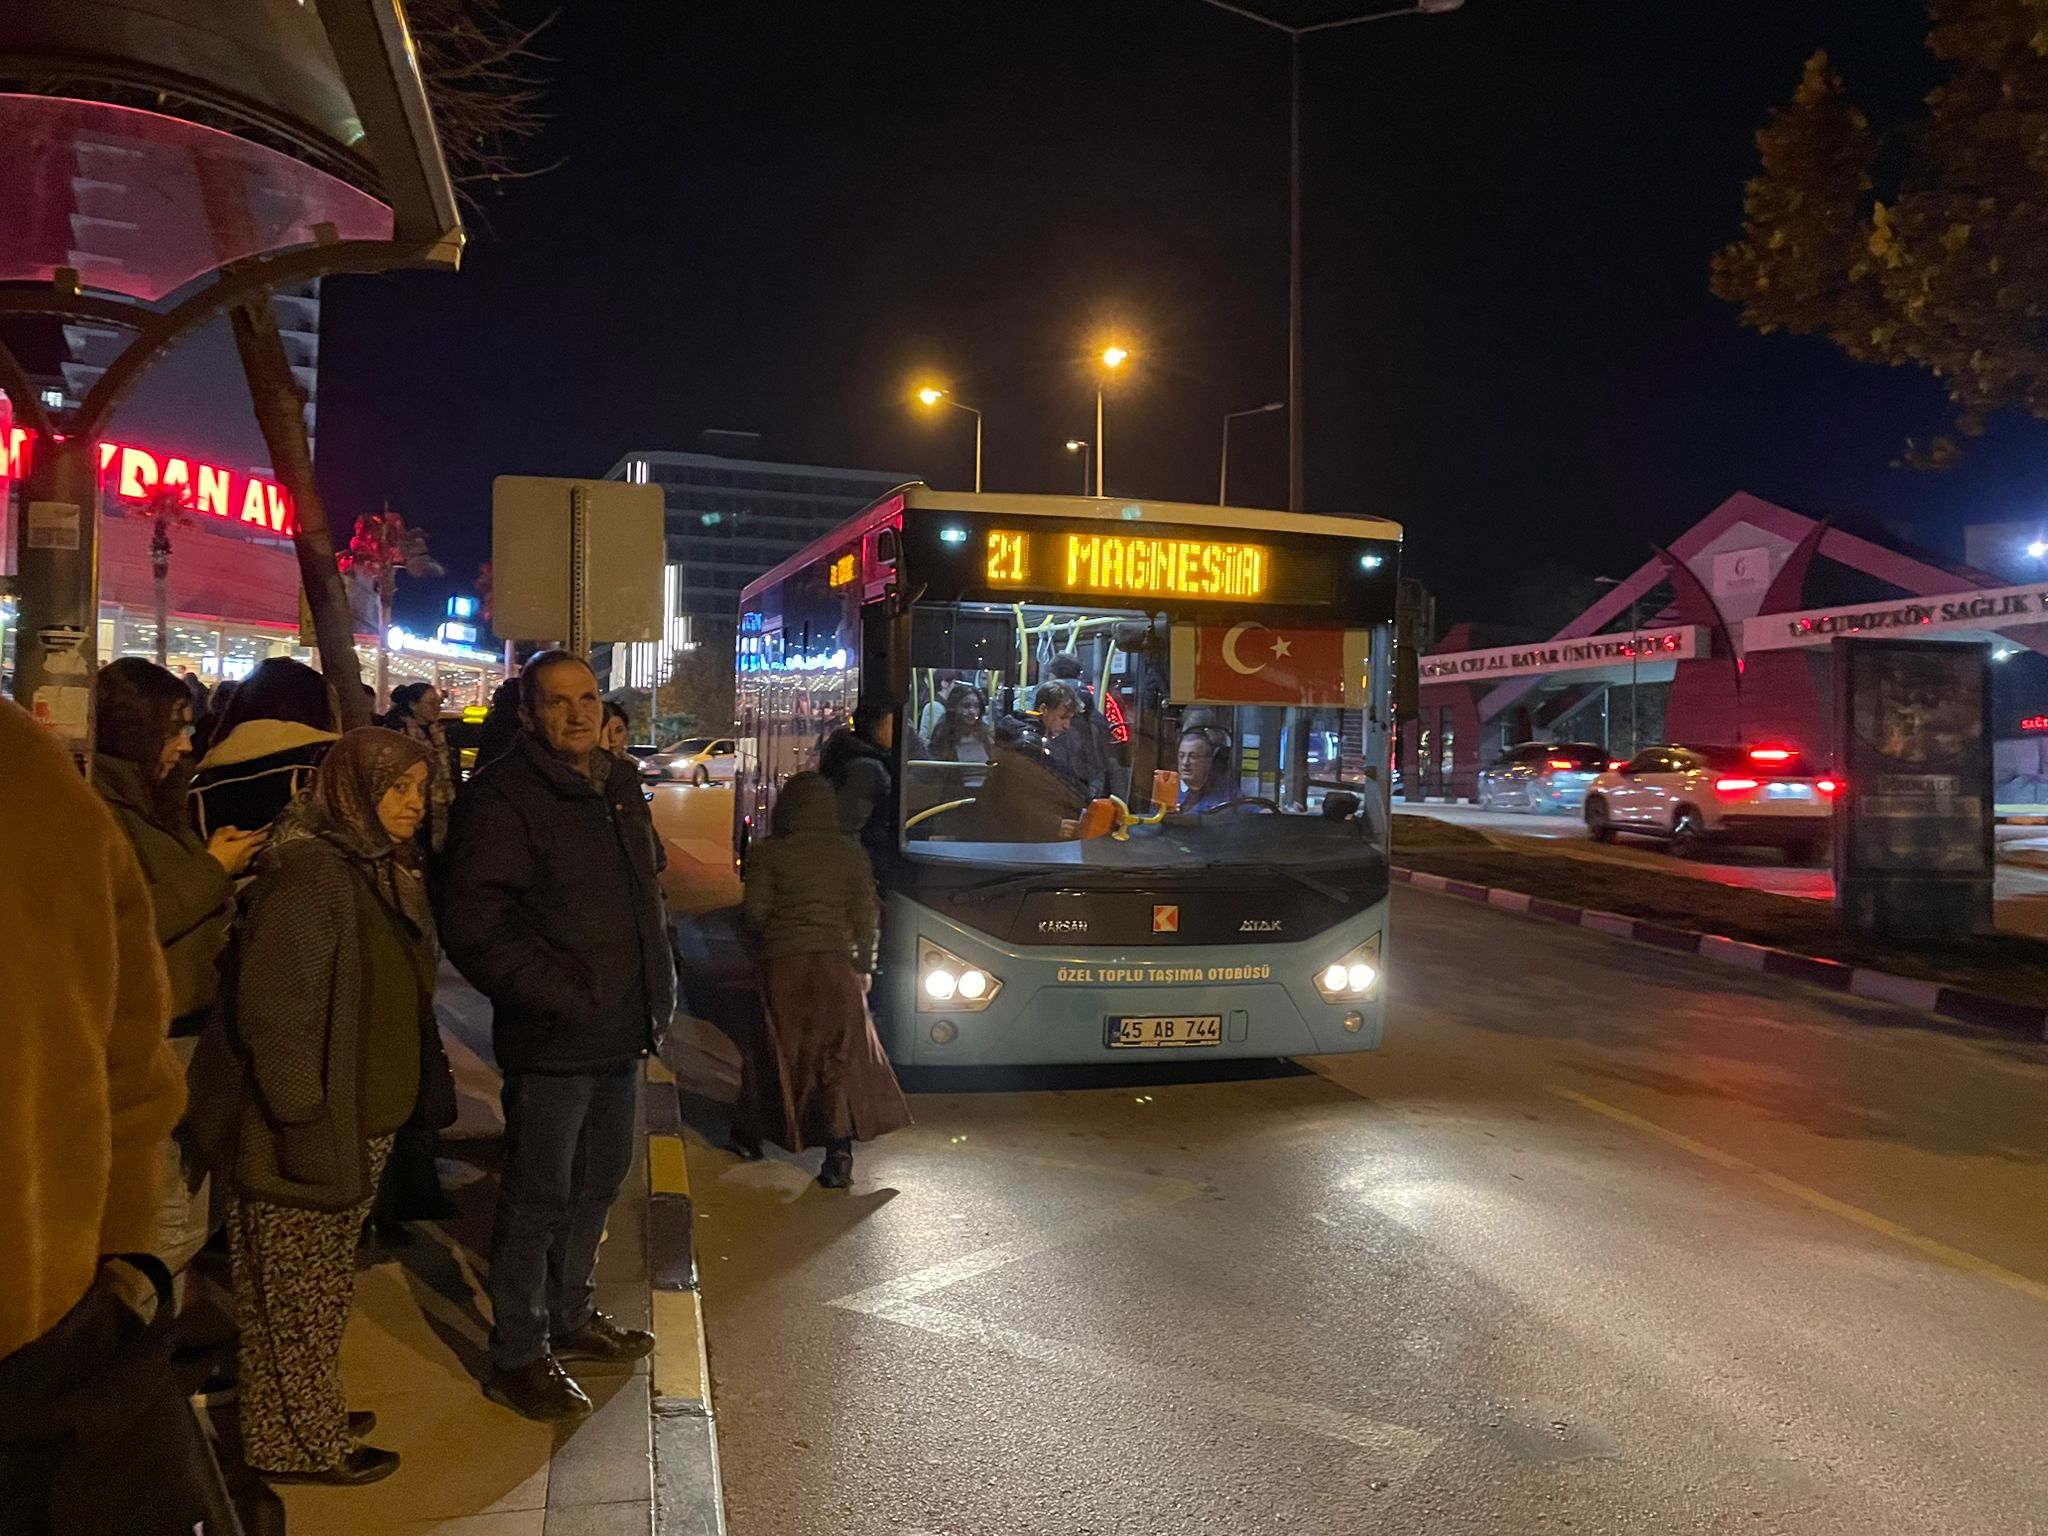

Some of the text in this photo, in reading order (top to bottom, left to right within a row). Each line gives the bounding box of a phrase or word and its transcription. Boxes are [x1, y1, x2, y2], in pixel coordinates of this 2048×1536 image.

[240, 478, 294, 536] AV
[988, 533, 1023, 580] 21
[1420, 660, 1459, 677] ANİSA
[1057, 963, 1270, 983] ÖZEL TOPLU TAŞIMA OTOBÜSÜ
[1121, 1021, 1143, 1039] 45
[1154, 1021, 1174, 1038] AB
[1187, 1020, 1217, 1037] 744
